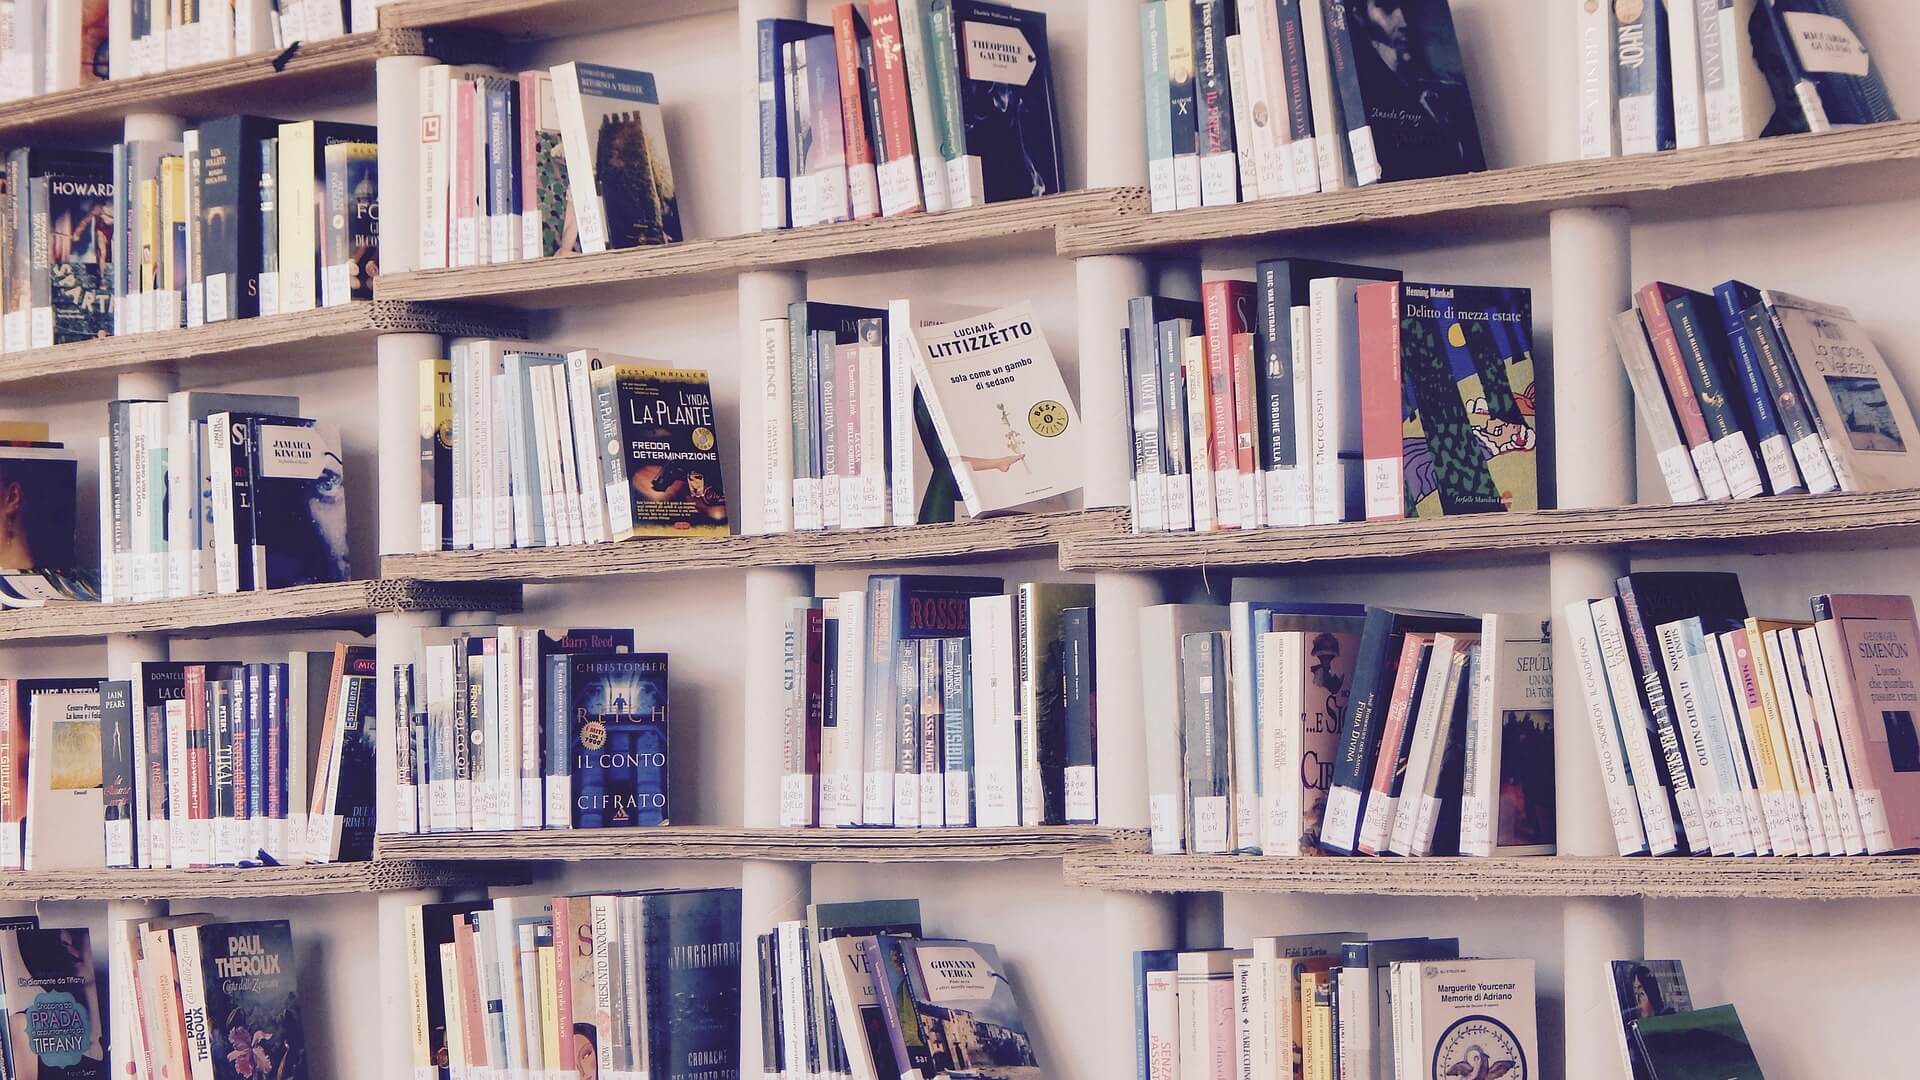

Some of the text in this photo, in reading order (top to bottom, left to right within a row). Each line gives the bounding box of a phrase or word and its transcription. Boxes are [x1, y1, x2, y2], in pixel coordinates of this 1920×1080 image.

[1203, 3, 1214, 77] TESS GERRITSEN
[1619, 24, 1645, 69] JOHN
[979, 52, 1018, 64] GAUTIER
[1206, 90, 1216, 103] IL
[52, 181, 113, 197] HOWARD
[1266, 271, 1274, 288] ERIC
[1406, 286, 1454, 299] Henning Mankell
[1267, 303, 1276, 342] LUSTBADER
[1407, 304, 1522, 322] Delitto di mezza estate
[928, 321, 1033, 358] LITTIZZETTO
[953, 321, 995, 337] LUCIANA
[765, 327, 775, 401] LAWRENCE
[1682, 316, 1711, 389] VALERIO MASSIMO MANFREDI
[1755, 326, 1784, 389] VALERIO MASSIMO MANFREDI
[652, 370, 709, 380] THRILLER
[847, 364, 855, 397] Charlotte
[950, 356, 1033, 384] sola come un gambo
[975, 374, 1015, 391] di sedano
[1208, 295, 1226, 447] SARAH LOVETT MOVENTE
[1743, 353, 1759, 394] MASSIMO MANFREDI
[1829, 361, 1877, 375] Venezia
[679, 391, 709, 406] LYNDA
[1141, 373, 1154, 405] LEONI
[630, 399, 712, 427] LA PLANTE
[823, 381, 834, 431] VAMPIRO
[1034, 404, 1057, 417] BEST
[1271, 394, 1280, 433] L'ORDINE
[600, 407, 612, 438] PLANTE
[1316, 390, 1325, 465] Microcosmi
[273, 440, 312, 451] JAMAICA
[274, 449, 312, 460] KINCAID
[632, 441, 670, 451] FREDDA
[633, 451, 717, 461] DETERMINAZIONE
[1135, 432, 1144, 466] Llywelyn
[1272, 436, 1281, 463] DELLA
[1815, 604, 1824, 613] 27
[874, 588, 888, 663] ROSSELLA
[1622, 591, 1652, 670] Sidney Sheldon
[561, 635, 613, 650] Barry Reed
[1597, 614, 1618, 669] L'ULTIMA
[1609, 627, 1625, 664] VALLE
[1664, 629, 1679, 672] SHELDON
[1671, 628, 1683, 661] SIDNEY
[1859, 642, 1910, 659] SIMENON
[151, 672, 185, 681] DONATELL
[576, 662, 667, 673] CHRISTOPHER
[945, 660, 954, 699] ROBINSON
[953, 663, 961, 694] PATRICK
[1874, 664, 1901, 676] L'uomo
[107, 691, 123, 700] IAIN
[159, 688, 172, 699] LA
[250, 675, 259, 719] Ellis Peters
[268, 675, 277, 719] Ellis Peters
[1742, 664, 1756, 705] MAIGRET
[1869, 679, 1883, 688] che
[67, 704, 85, 712] Cesare
[105, 700, 126, 710] PEARS
[234, 679, 243, 723] Ellis Peters
[345, 680, 358, 731] Esperienze
[470, 684, 478, 719] RANKIN
[577, 706, 666, 723] REICH
[1578, 637, 1616, 784] CARLO SGORLON CALDERAS
[1643, 671, 1677, 752] NULLA PER
[66, 712, 87, 720] La luna
[902, 703, 913, 744] CLASSE
[1361, 707, 1372, 740] RODRIGUES
[1683, 693, 1708, 766] VOLTO NUDO
[171, 725, 179, 766] STRADE
[585, 738, 602, 746] 7900
[945, 708, 962, 769] INVISIBIL
[1346, 700, 1366, 763] FURIA DIVINA
[217, 745, 233, 790] TIKAL
[577, 753, 666, 769] IL CONTO
[1, 755, 10, 807] GIULLARE
[577, 793, 666, 810] CIFRATO
[228, 936, 264, 956] PAUL
[554, 909, 564, 971] Joanna Trollope
[215, 955, 281, 978] THEROUX
[595, 906, 609, 1008] PRESUNTO INNOCENTE
[930, 959, 976, 970] GIOVANNI
[28, 975, 84, 986] diamante da Tiffany
[941, 968, 973, 978] VERGA
[1437, 981, 1516, 994] Marguerite Yourcenar
[1441, 991, 1512, 1003] Memorie di Adriano
[31, 1010, 83, 1028] PRADA
[186, 1009, 195, 1039] PAUL
[33, 1036, 83, 1053] TIFFANY
[194, 1007, 209, 1062] THEROUX
[602, 1045, 610, 1070] TUROW
[688, 1049, 728, 1064] CRONACHE
[1151, 1035, 1160, 1080] PASSAT
[1160, 1042, 1172, 1080] SENZA
